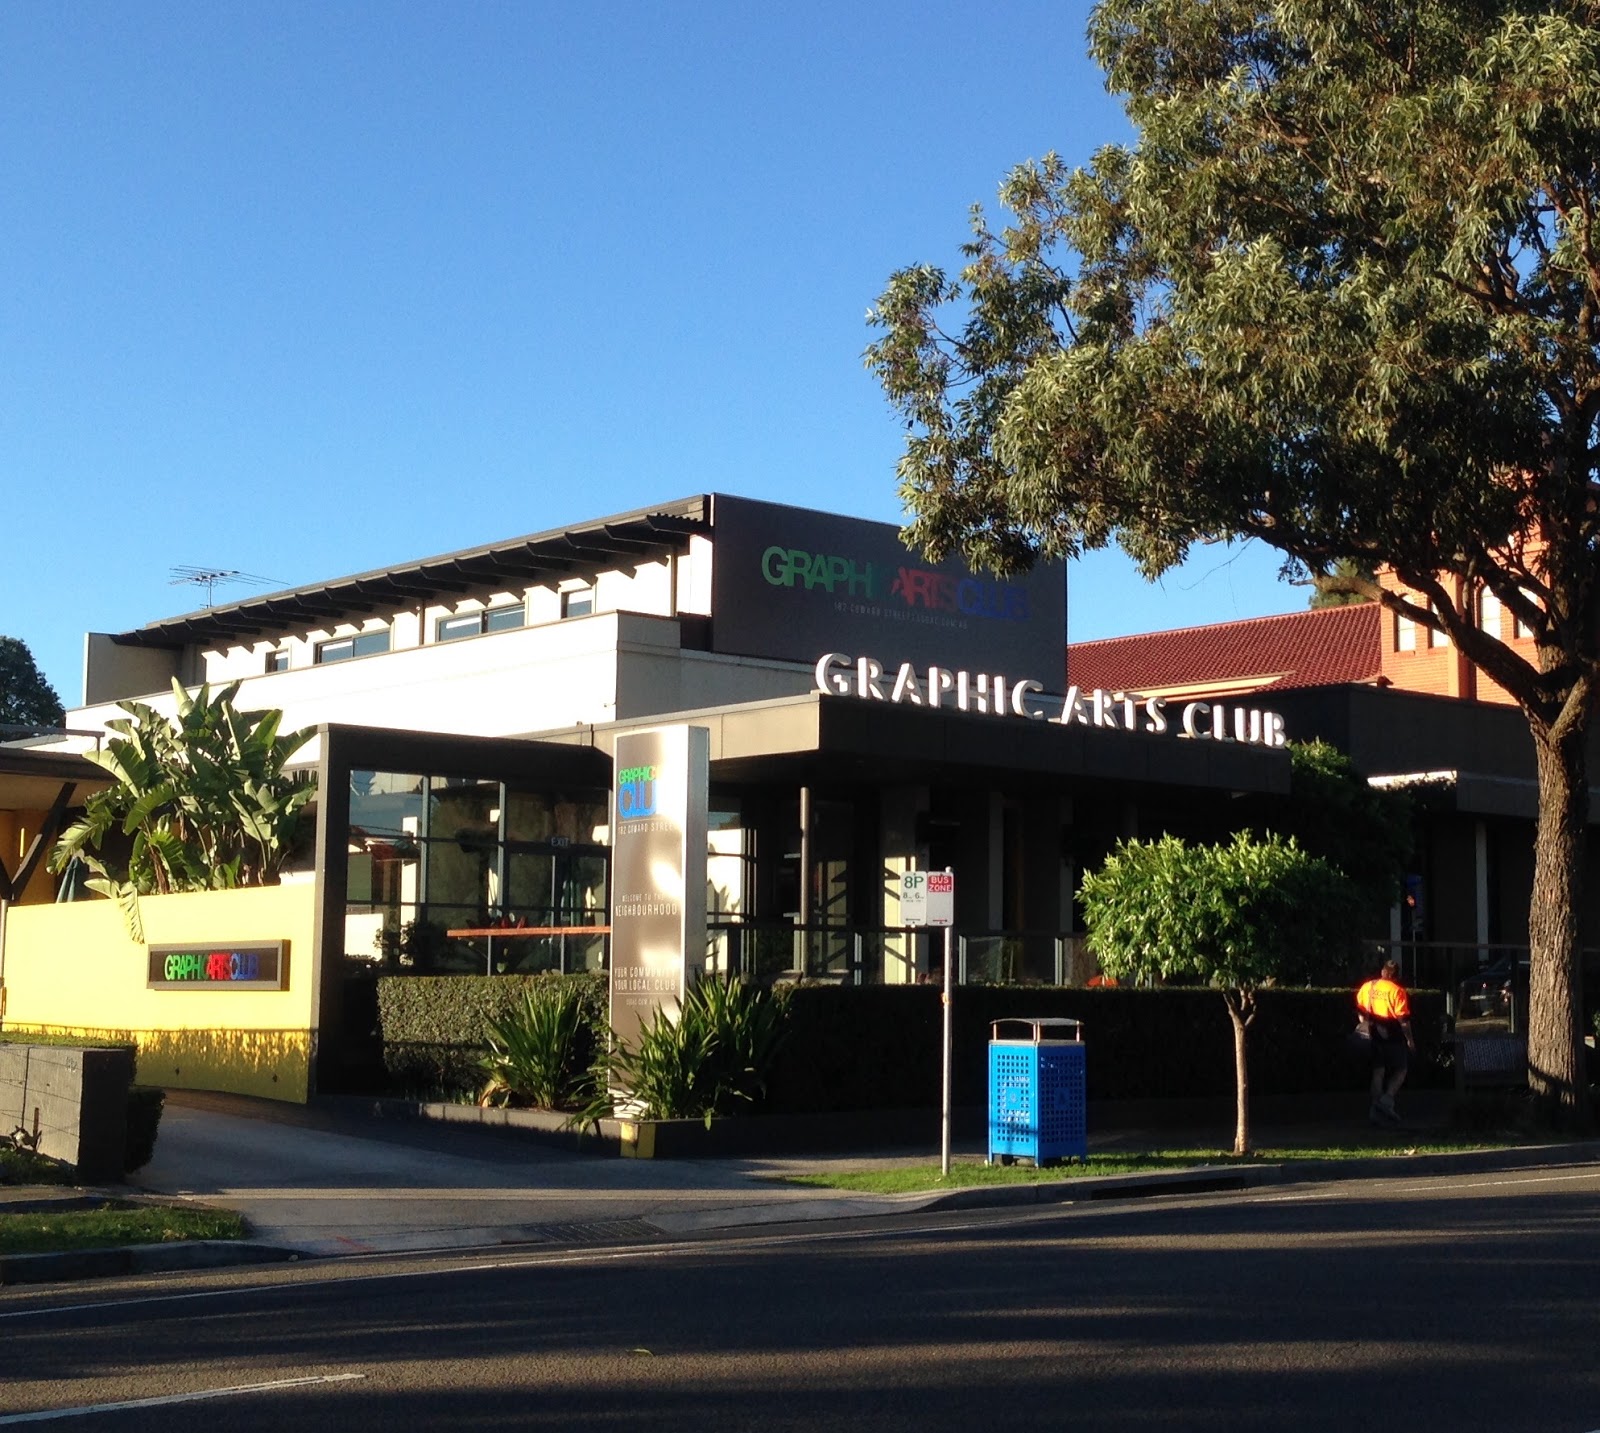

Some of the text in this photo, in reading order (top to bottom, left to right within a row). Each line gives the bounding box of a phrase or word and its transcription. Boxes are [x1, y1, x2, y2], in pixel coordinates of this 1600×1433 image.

[815, 653, 1287, 748] GRAPHIC ARTS CLUB
[551, 837, 569, 847] EXIT
[904, 876, 924, 889] 8P
[931, 876, 949, 884] BUS
[929, 884, 952, 892] ZONE
[615, 903, 678, 917] NEIGHBOURHOOD
[629, 979, 651, 991] LOCAL
[654, 979, 676, 991] CLUB
